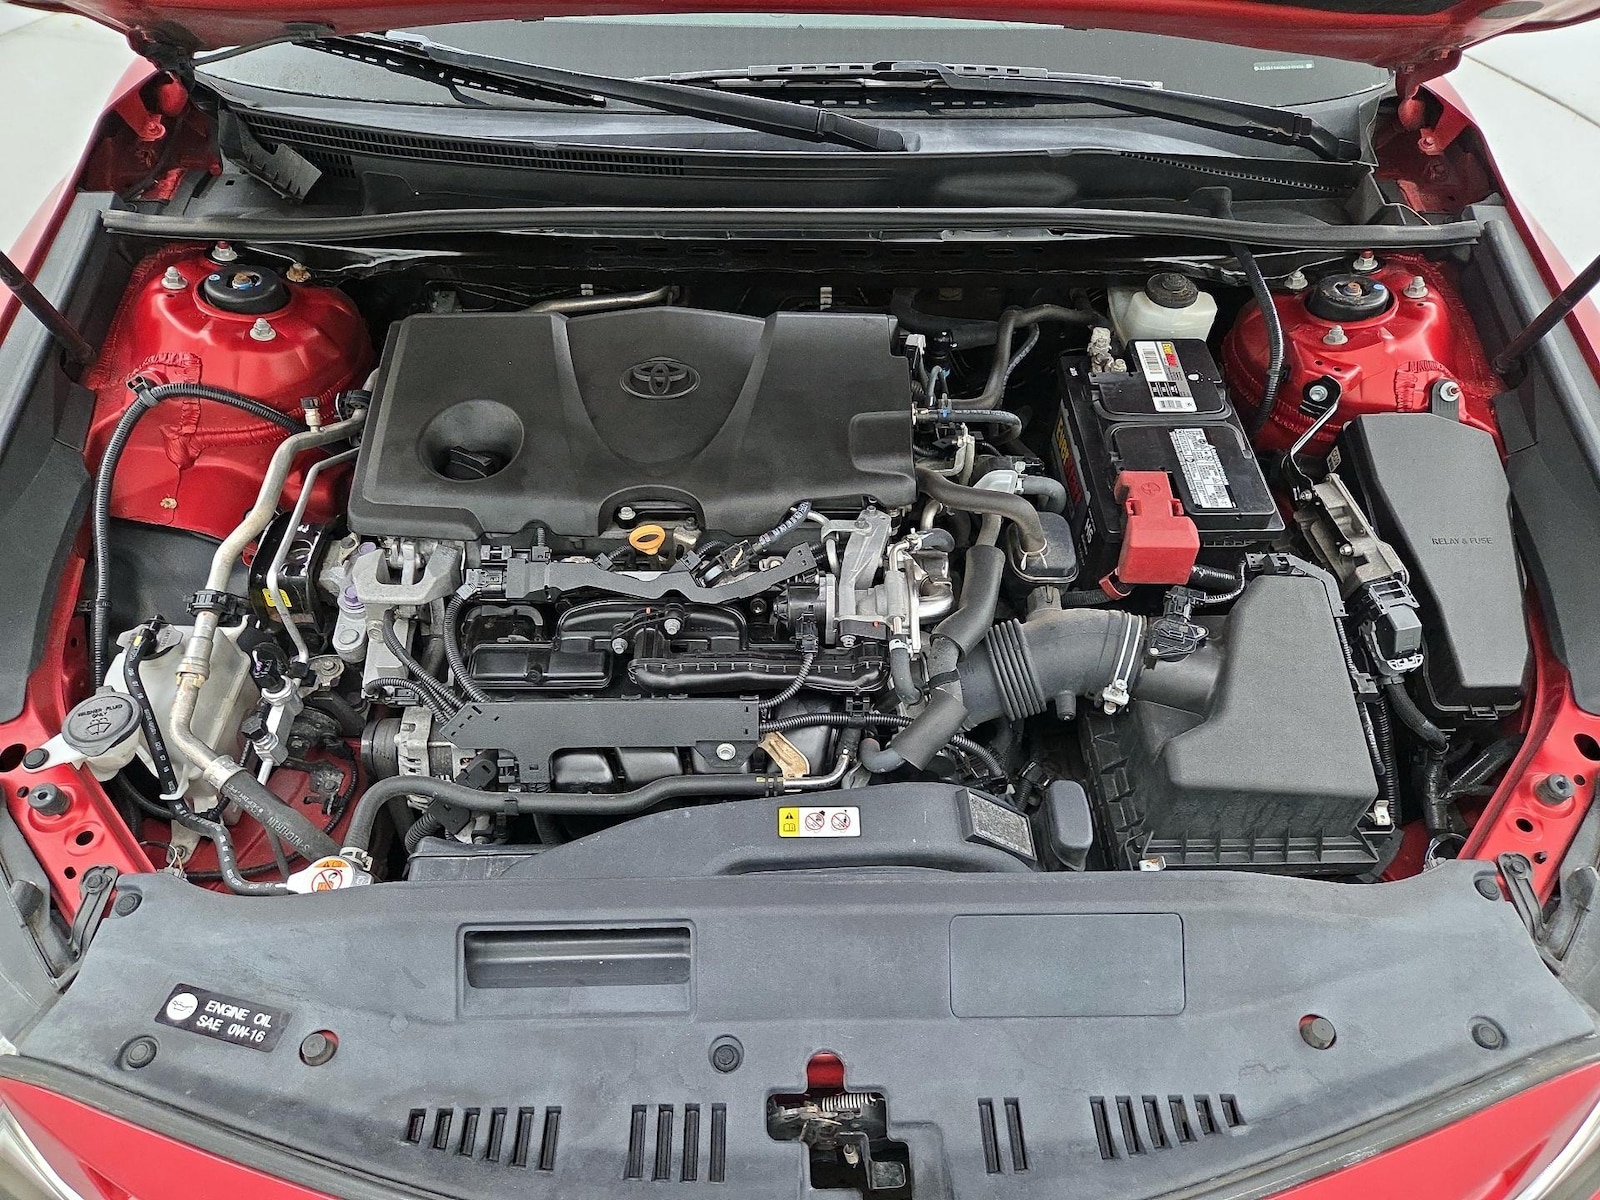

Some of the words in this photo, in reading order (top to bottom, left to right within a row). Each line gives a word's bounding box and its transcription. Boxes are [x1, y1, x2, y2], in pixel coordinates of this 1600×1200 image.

[1431, 537, 1459, 545] RELAY
[1461, 537, 1468, 545] &
[1469, 537, 1493, 545] FUSE
[205, 1000, 251, 1021] ENGINE
[253, 1013, 272, 1028] OIL
[196, 1015, 224, 1031] SAE
[227, 1023, 267, 1043] 0W-16
